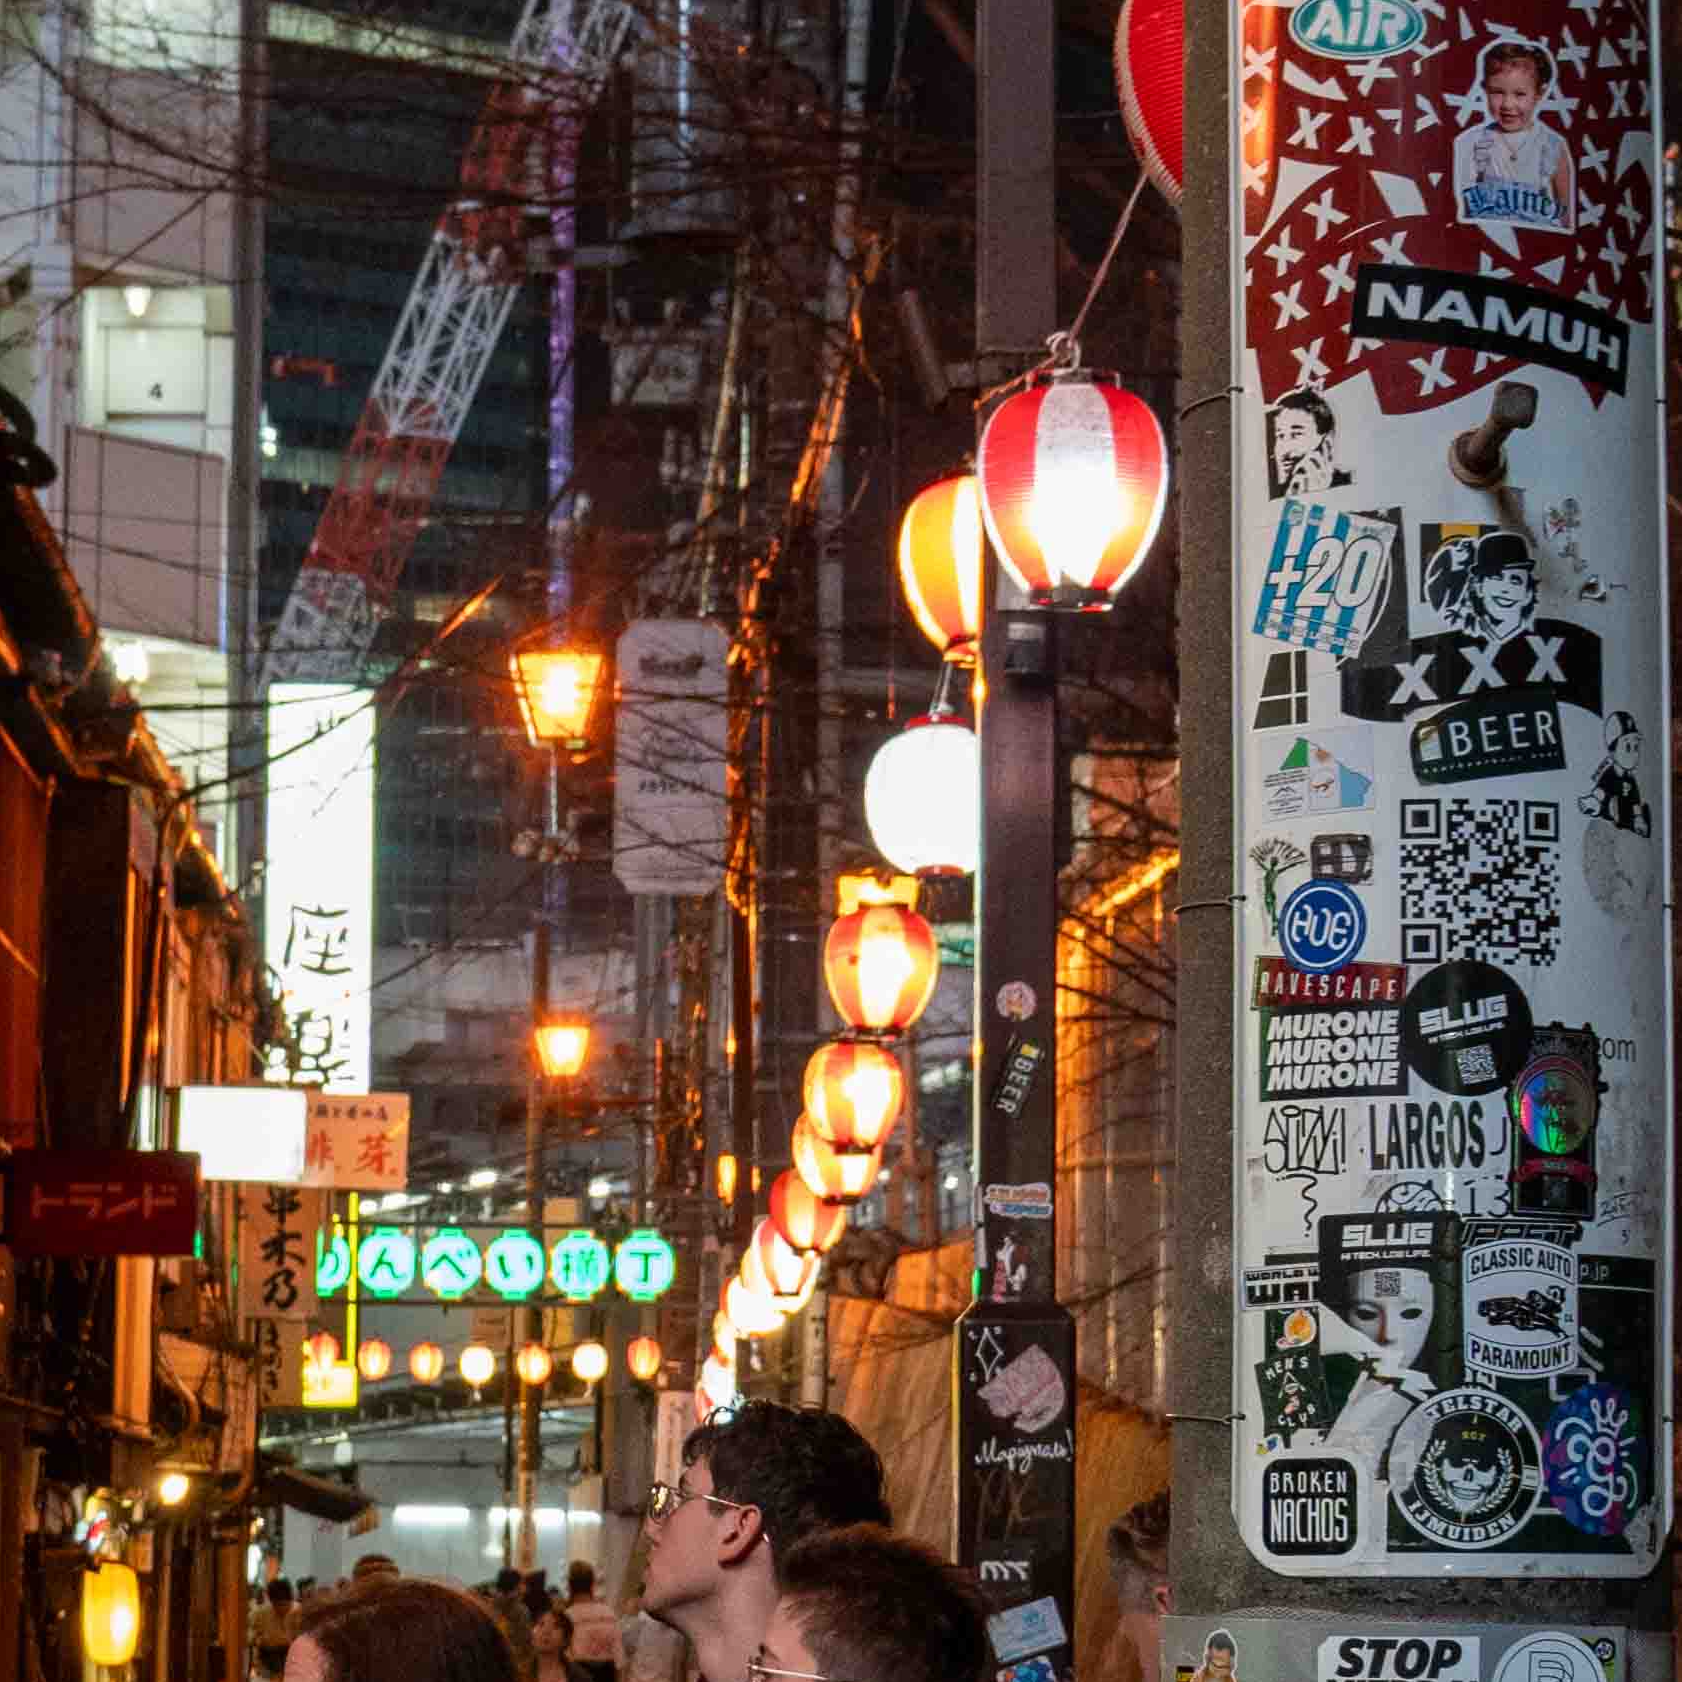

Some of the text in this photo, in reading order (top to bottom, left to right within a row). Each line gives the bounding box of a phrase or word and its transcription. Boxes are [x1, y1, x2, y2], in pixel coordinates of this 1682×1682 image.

[1366, 280, 1621, 371] NAMUH
[1447, 710, 1558, 757] BEER
[1291, 903, 1352, 951] HUE
[1267, 1008, 1400, 1041] MURONE
[1419, 993, 1509, 1035] SLUG
[1267, 1035, 1400, 1066] MURONE
[996, 1056, 1034, 1114] BEER
[1267, 1061, 1400, 1092] MURONE
[1369, 1100, 1485, 1170] LARGOS
[1341, 1222, 1434, 1248] SLUG
[1469, 1246, 1573, 1280] CLASSIC AUTO
[1469, 1341, 1572, 1371] PARAMOUNT
[1277, 1403, 1316, 1427] CLUB
[1425, 1394, 1522, 1433] TELSTAR
[1269, 1471, 1348, 1494] BROKEN
[1269, 1498, 1349, 1544] NACHOS
[1407, 1499, 1518, 1543] IJMUIDEN
[1335, 1637, 1463, 1680] STOP
